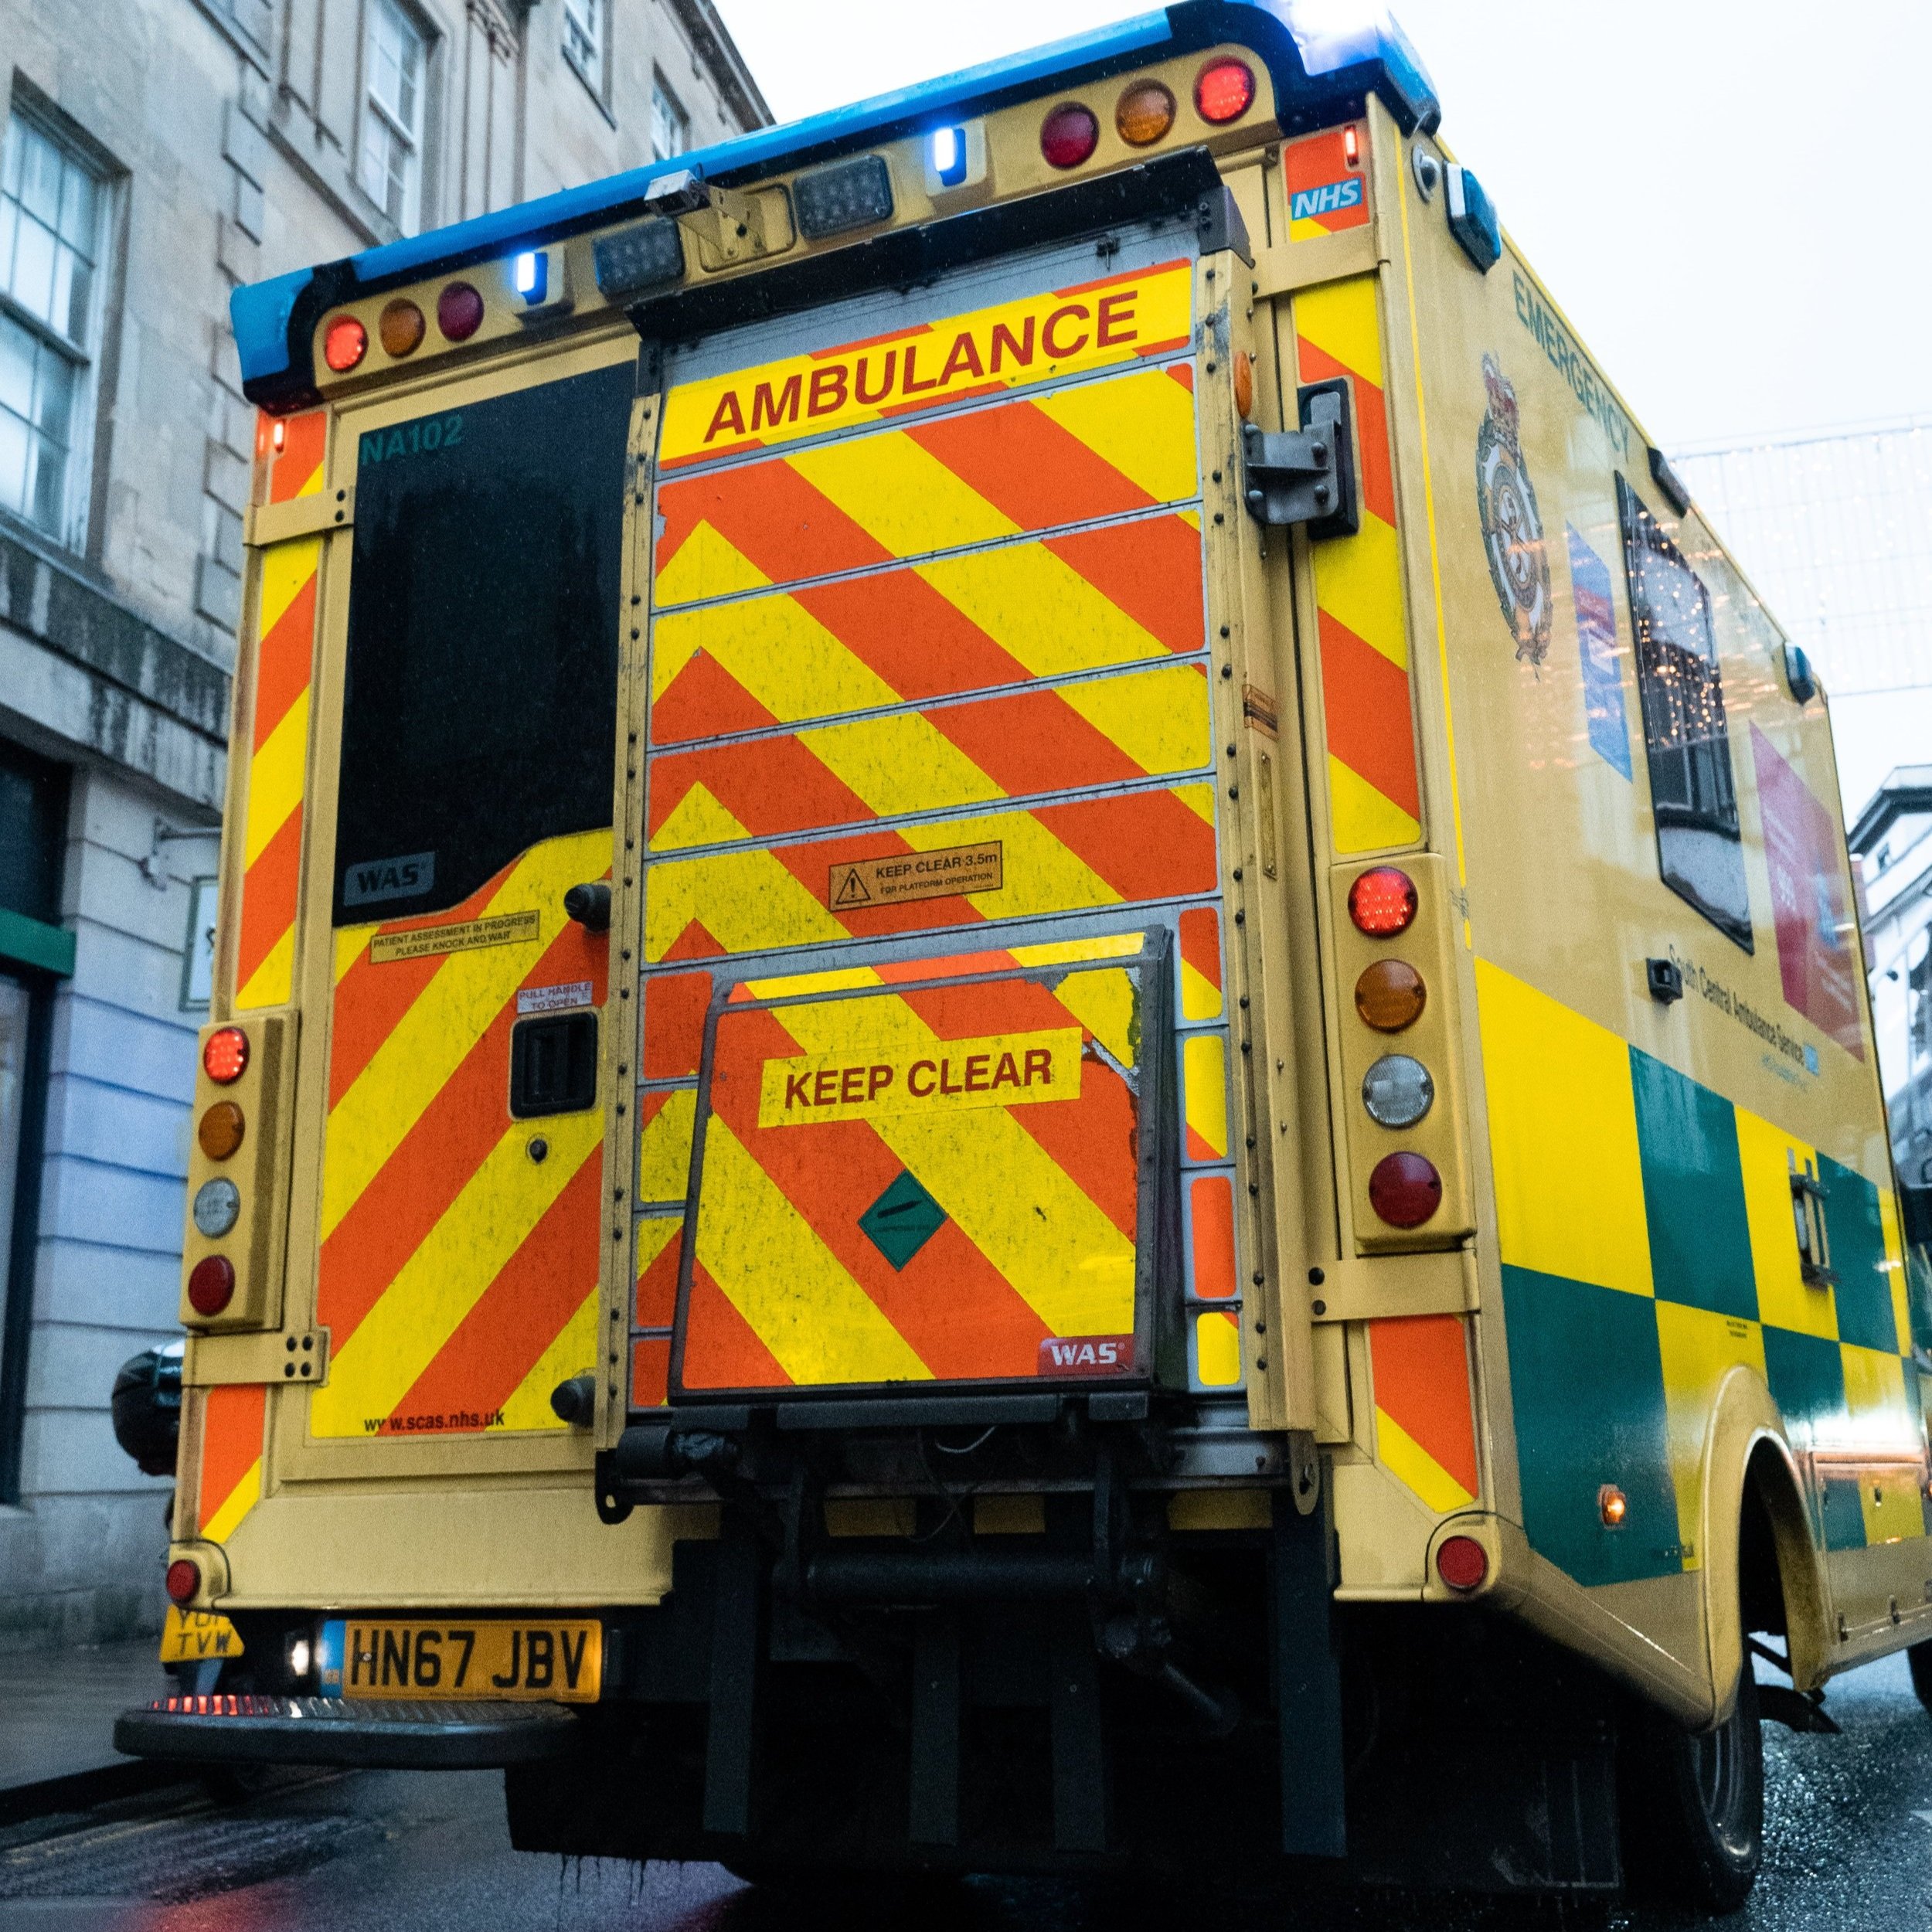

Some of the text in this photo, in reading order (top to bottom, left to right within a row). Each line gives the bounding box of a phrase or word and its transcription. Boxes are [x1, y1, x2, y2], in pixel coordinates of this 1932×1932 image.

[1295, 179, 1359, 219] NHS
[702, 290, 1138, 444] AMBULANCE
[1512, 270, 1628, 464] EMERGENCY
[362, 414, 463, 466] NA102
[357, 863, 420, 893] WAS
[876, 853, 997, 879] KEEP CLEAR 3.5m
[880, 872, 993, 895] FOR PLATFORM OPERATION
[373, 915, 536, 947] PATIENT ASSESSMENT IN PROGRESS
[396, 930, 512, 956] PLEASE KNOCK AND WAIT
[519, 989, 545, 1000] PULL
[548, 982, 591, 996] HANDLE
[531, 998, 578, 1010] TO OPEN
[1733, 992, 1777, 1048] Ambulance
[784, 1049, 1053, 1109] KEEP CLEAR
[1051, 1342, 1117, 1366] WAS
[351, 1629, 588, 1689] HN67 JBV
